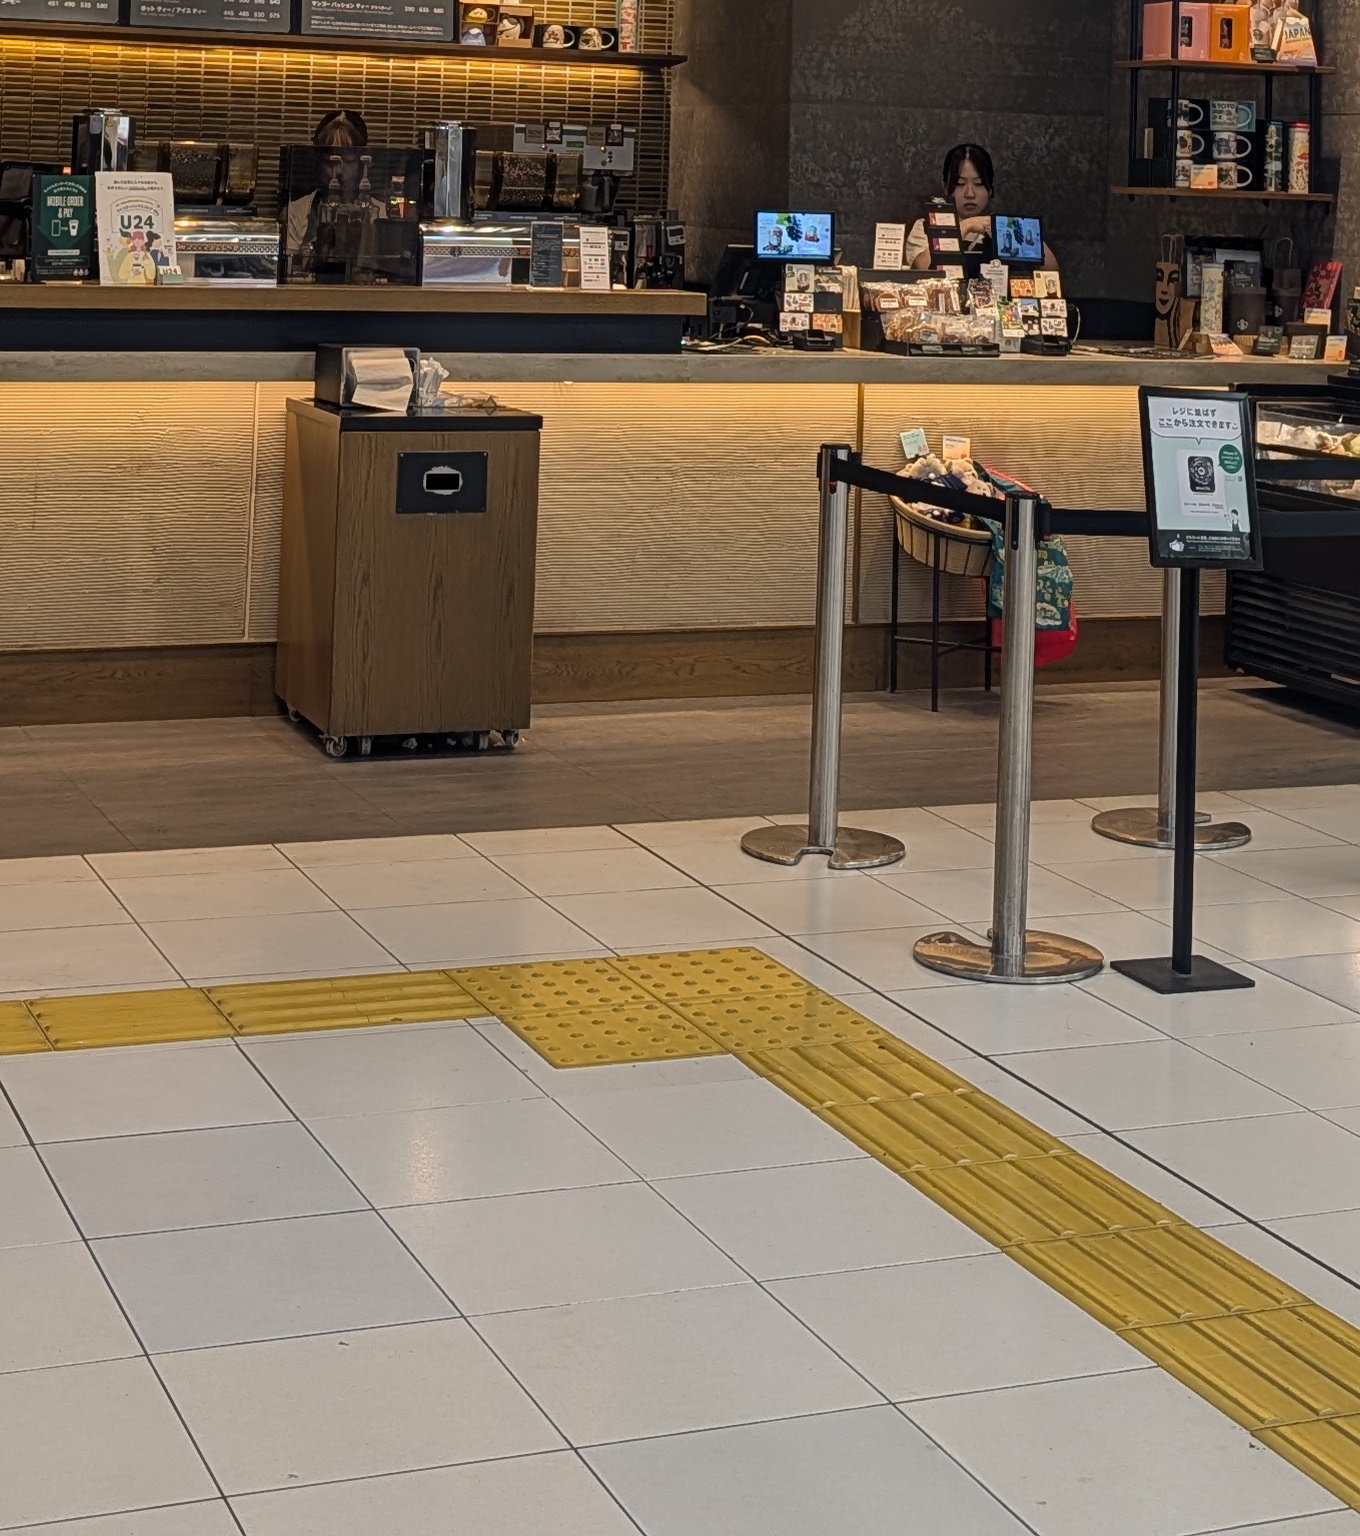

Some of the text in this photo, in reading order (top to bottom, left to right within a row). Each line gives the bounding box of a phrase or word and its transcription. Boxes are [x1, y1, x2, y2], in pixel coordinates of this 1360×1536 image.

[120, 215, 154, 229] U24
[1172, 407, 1216, 417] レジに並ばず
